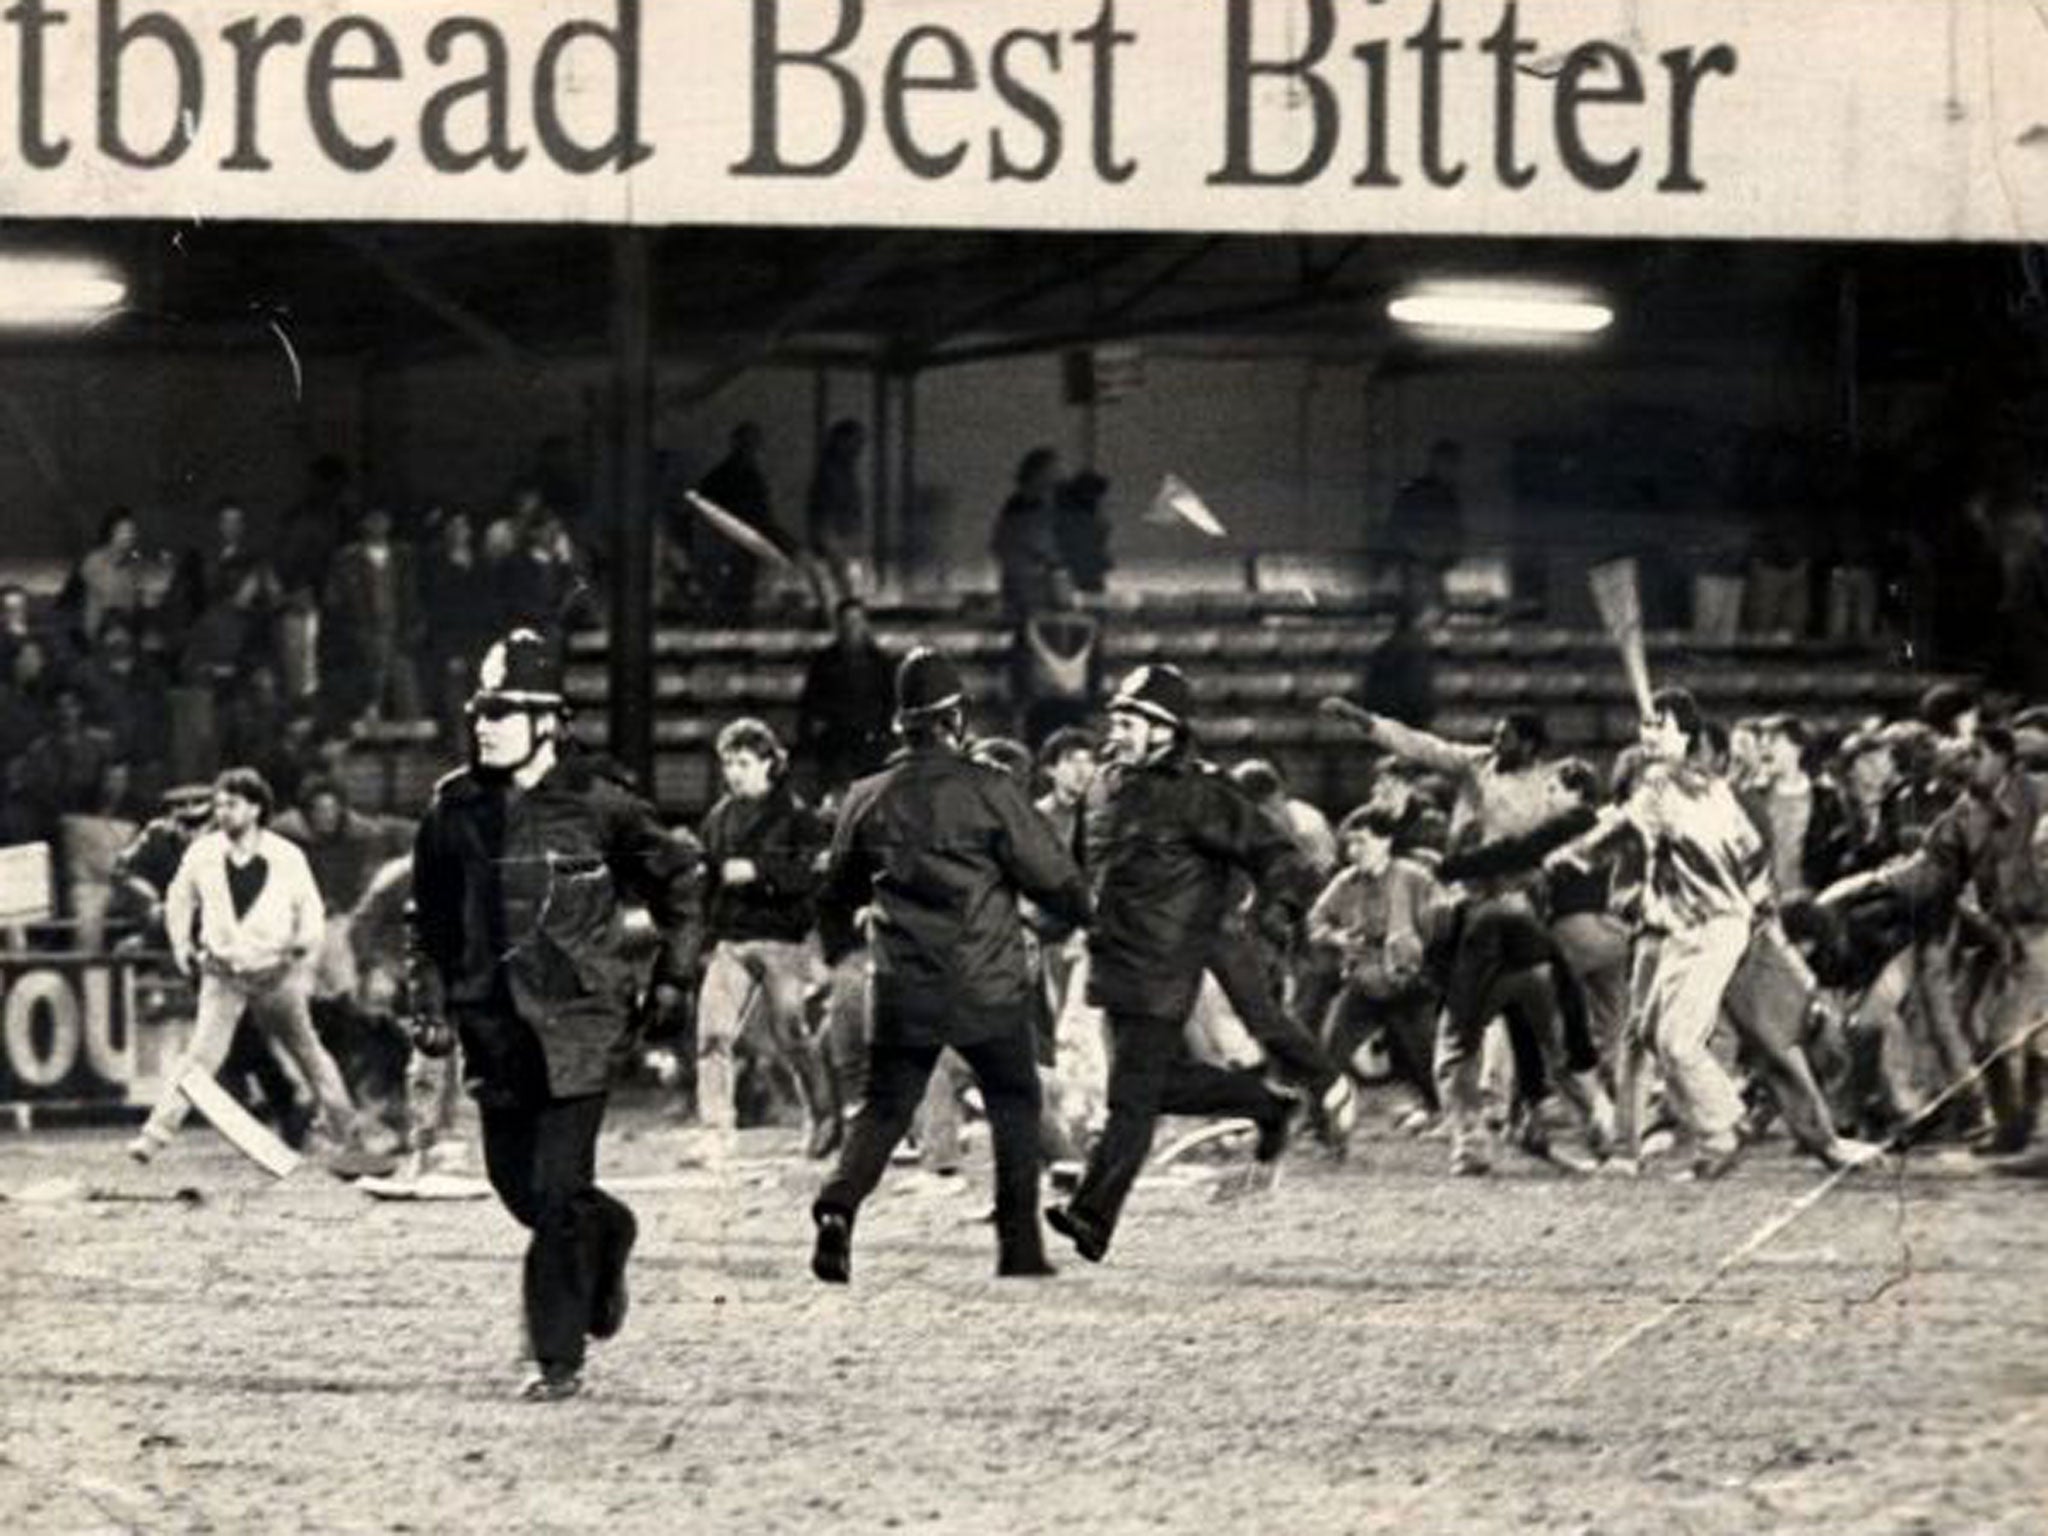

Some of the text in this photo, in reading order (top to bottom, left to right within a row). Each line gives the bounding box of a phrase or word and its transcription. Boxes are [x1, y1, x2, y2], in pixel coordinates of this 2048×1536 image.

[4, 0, 1738, 194] tbread Best Bitter
